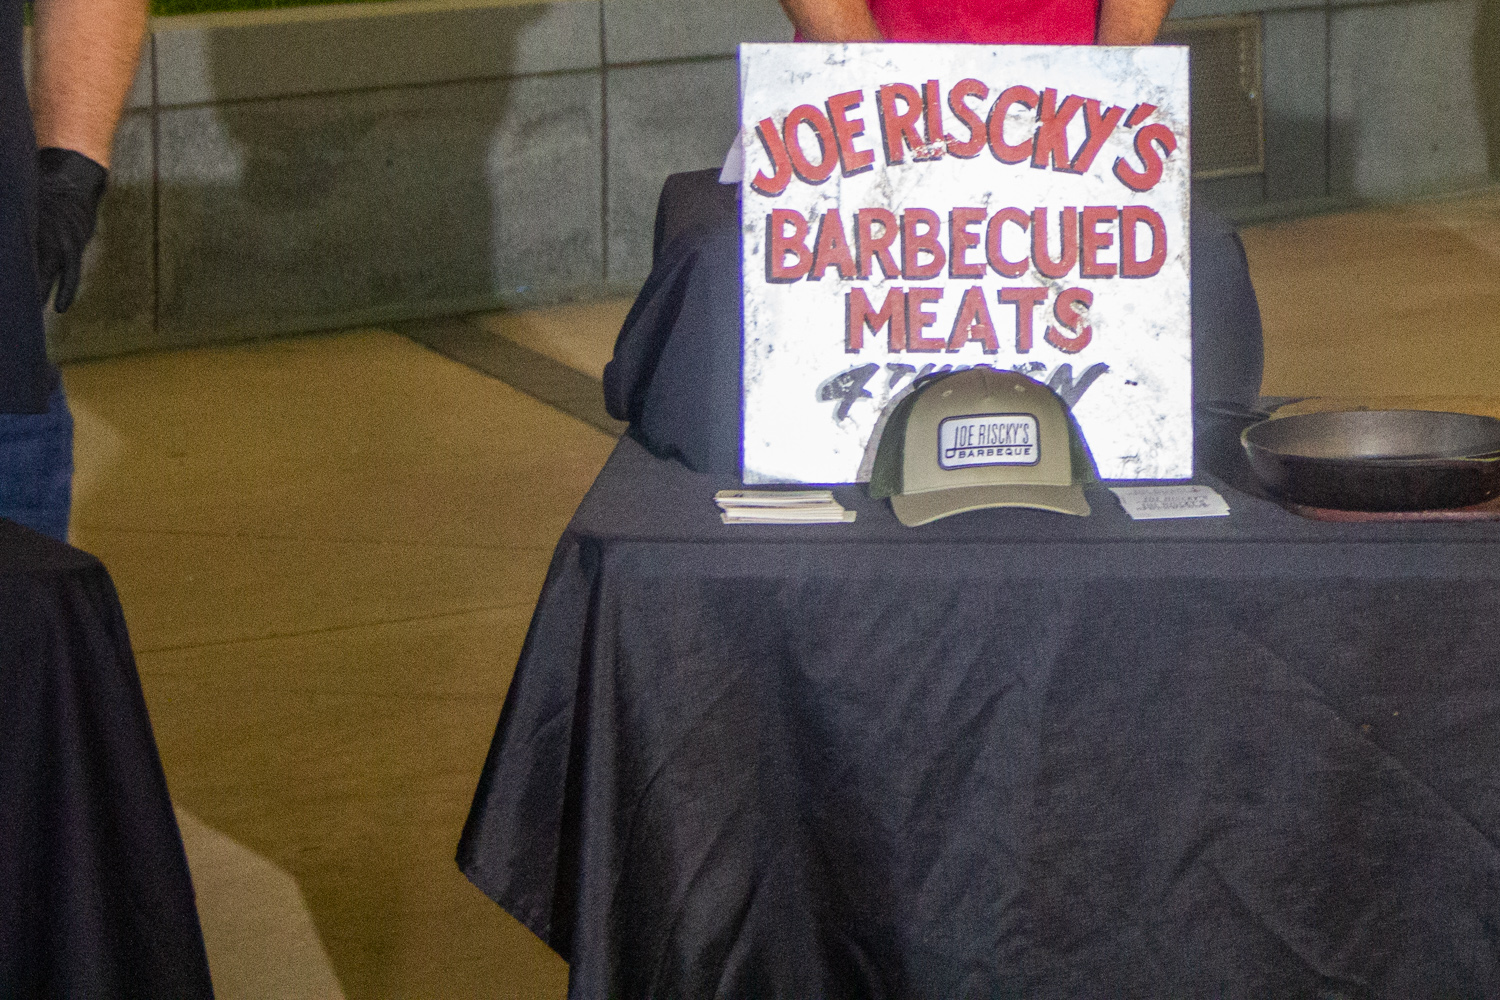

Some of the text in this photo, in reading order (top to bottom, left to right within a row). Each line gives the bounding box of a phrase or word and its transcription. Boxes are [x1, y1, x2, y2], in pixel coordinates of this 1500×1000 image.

[750, 78, 1178, 197] JOE RISCKY'S
[765, 205, 1168, 284] BARBECUED
[845, 286, 1095, 354] MEATS
[946, 422, 1030, 458] JOE RISCKY'S
[958, 447, 1031, 459] BARBEQUE
